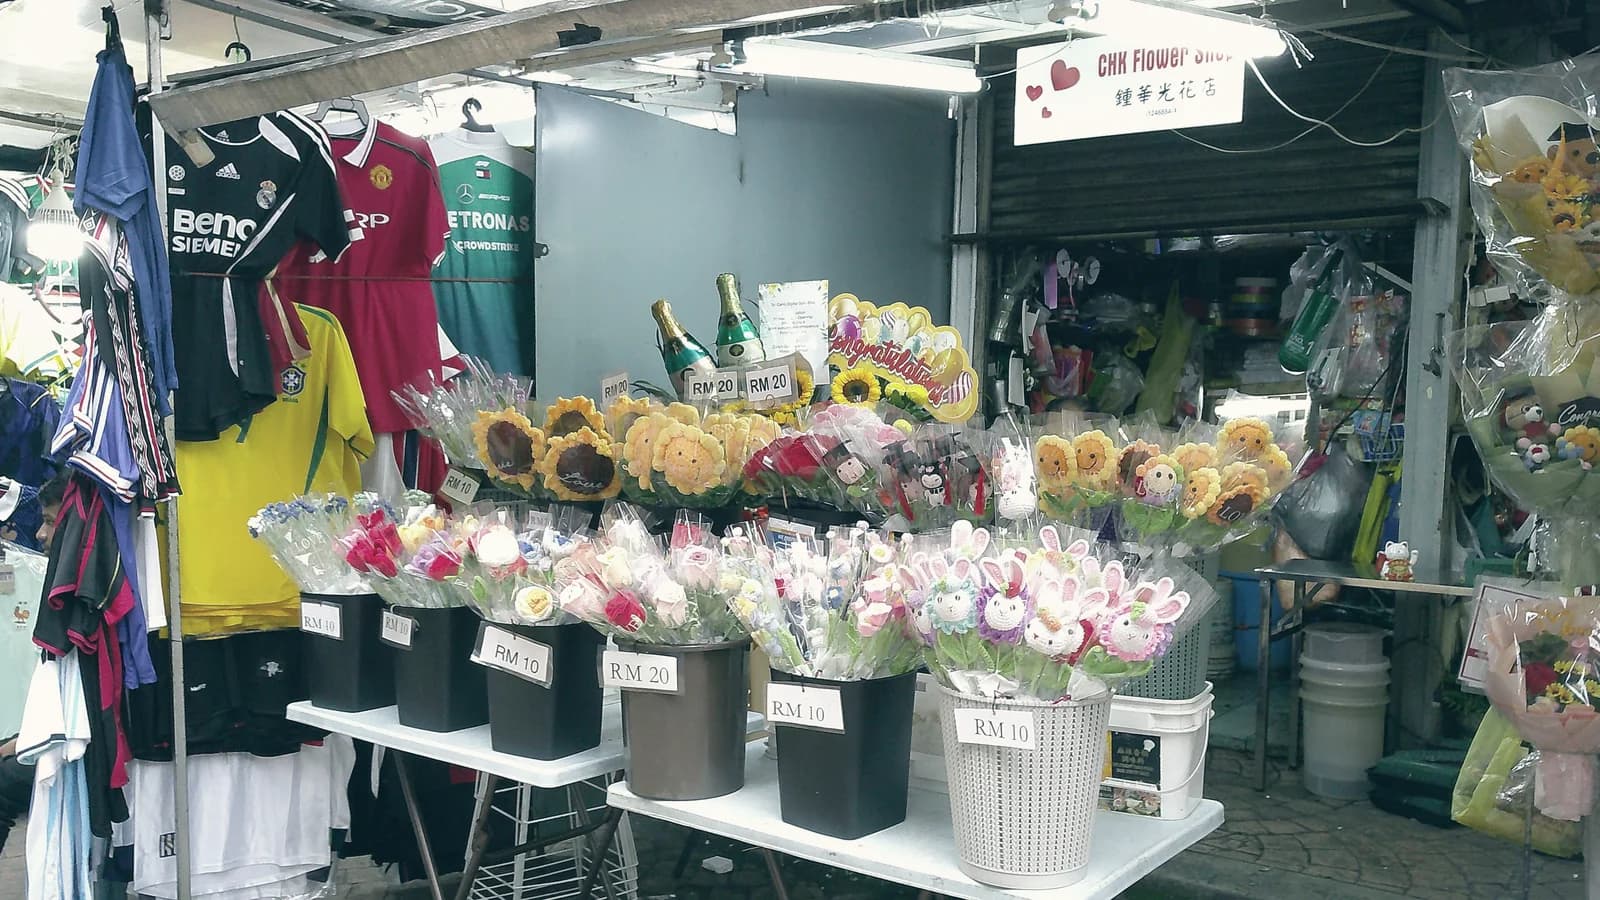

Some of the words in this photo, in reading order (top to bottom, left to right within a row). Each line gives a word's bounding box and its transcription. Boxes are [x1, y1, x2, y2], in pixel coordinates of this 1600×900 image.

[1098, 51, 1127, 78] CHK
[1133, 47, 1189, 73] Flower
[456, 240, 520, 252] CROWDSTRIKE
[605, 385, 618, 399] RM
[618, 379, 628, 393] 20
[692, 382, 714, 395] RM
[718, 379, 733, 392] 20
[750, 377, 769, 393] RM
[772, 373, 787, 389] 20
[445, 475, 459, 490] RM
[461, 482, 471, 494] 10
[304, 616, 322, 630] RM
[326, 620, 335, 633] 10
[385, 616, 398, 632] RM
[400, 623, 409, 635] 10
[495, 644, 518, 666] RM
[523, 657, 539, 674] 10
[610, 663, 642, 681] RM
[649, 667, 669, 684] 20
[772, 700, 801, 718] RM
[808, 706, 825, 722] 10
[974, 718, 1005, 738] RM
[1011, 725, 1029, 742] 10
